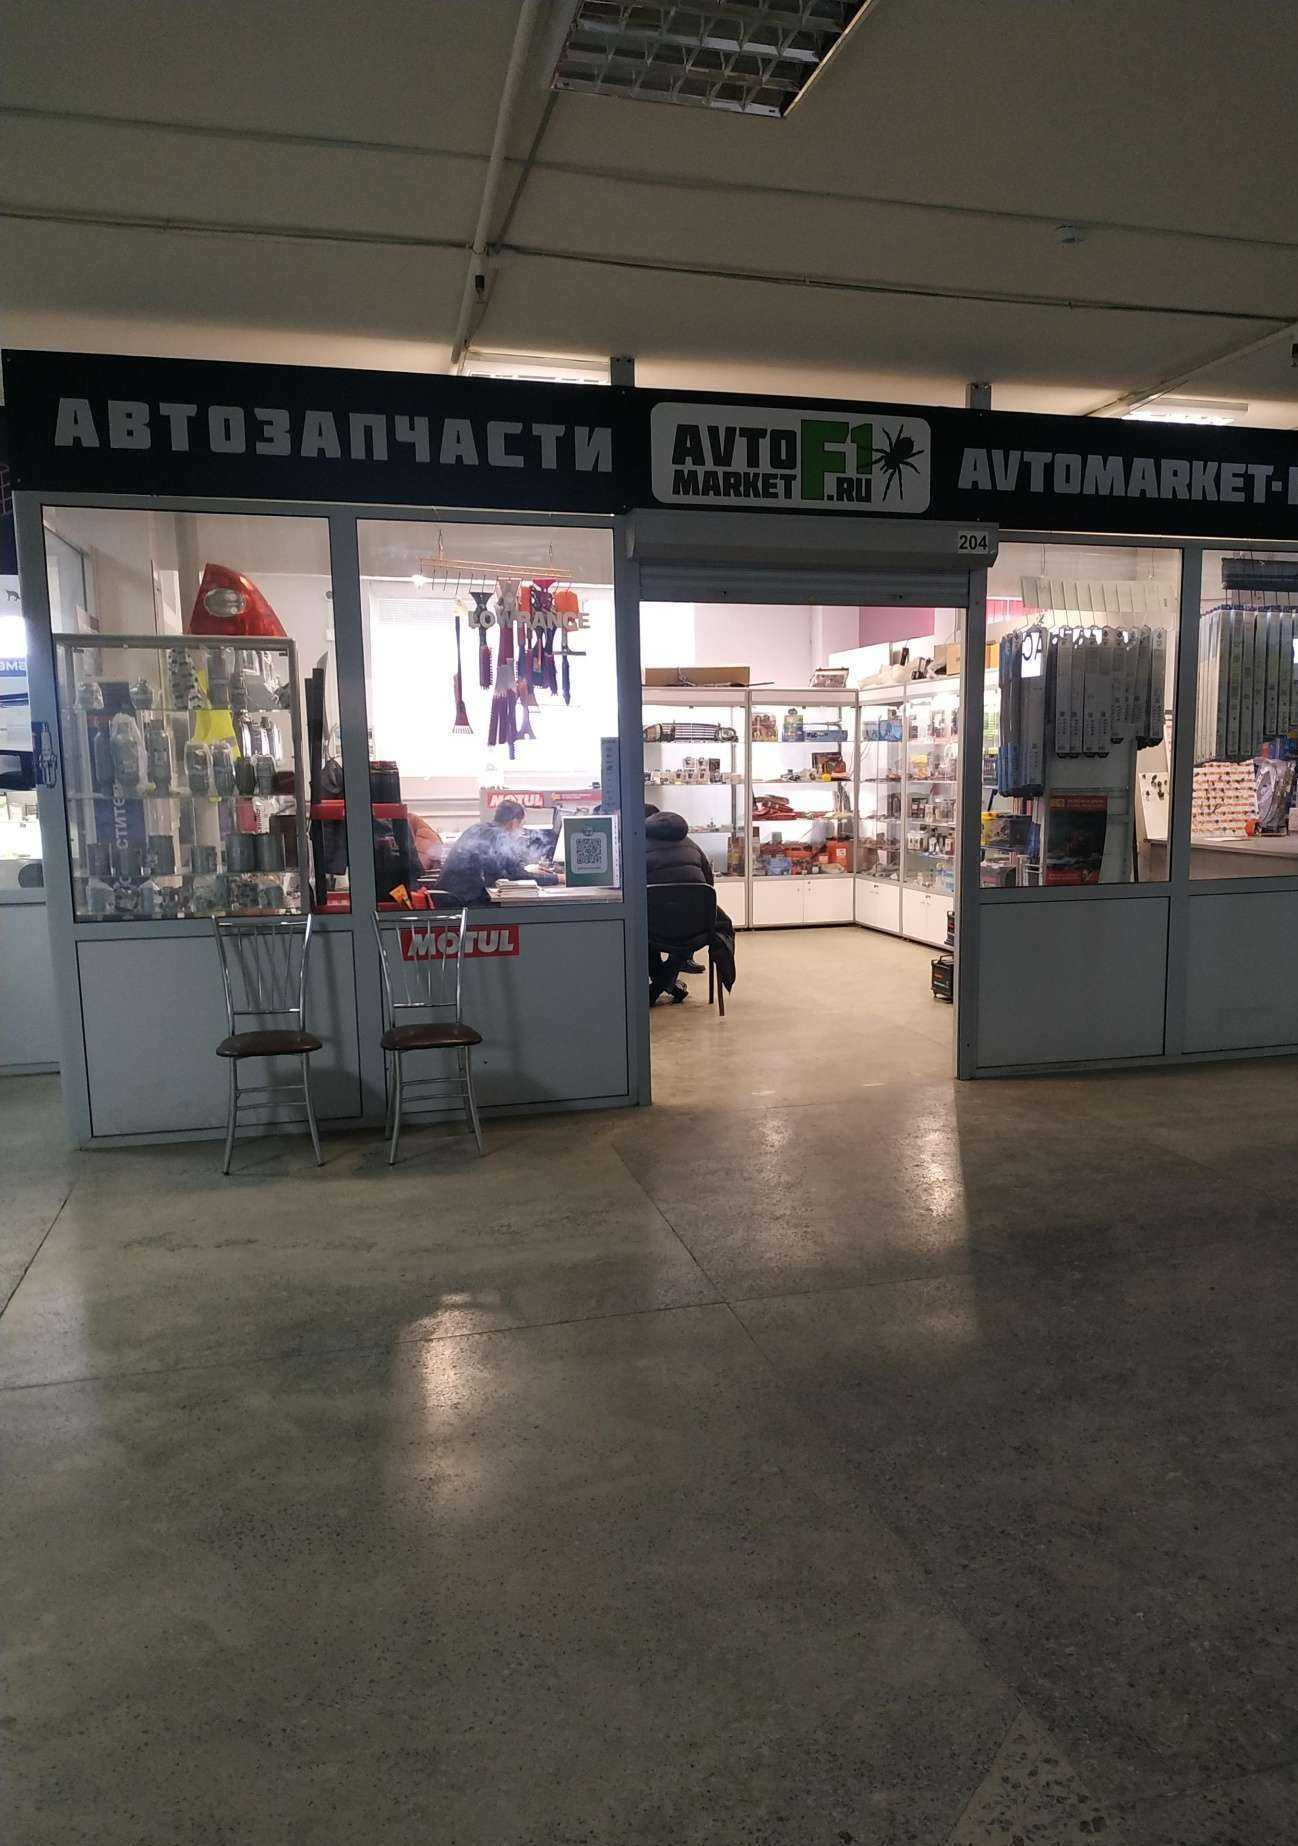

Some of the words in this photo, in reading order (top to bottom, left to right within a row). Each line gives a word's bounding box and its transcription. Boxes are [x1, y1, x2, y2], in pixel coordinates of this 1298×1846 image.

[54, 398, 613, 473] АВТОЗАПЧАСТИ
[672, 424, 797, 469] AVTO
[672, 470, 797, 499] MARKET
[958, 534, 988, 551] 204
[407, 929, 514, 957] MOTUL
